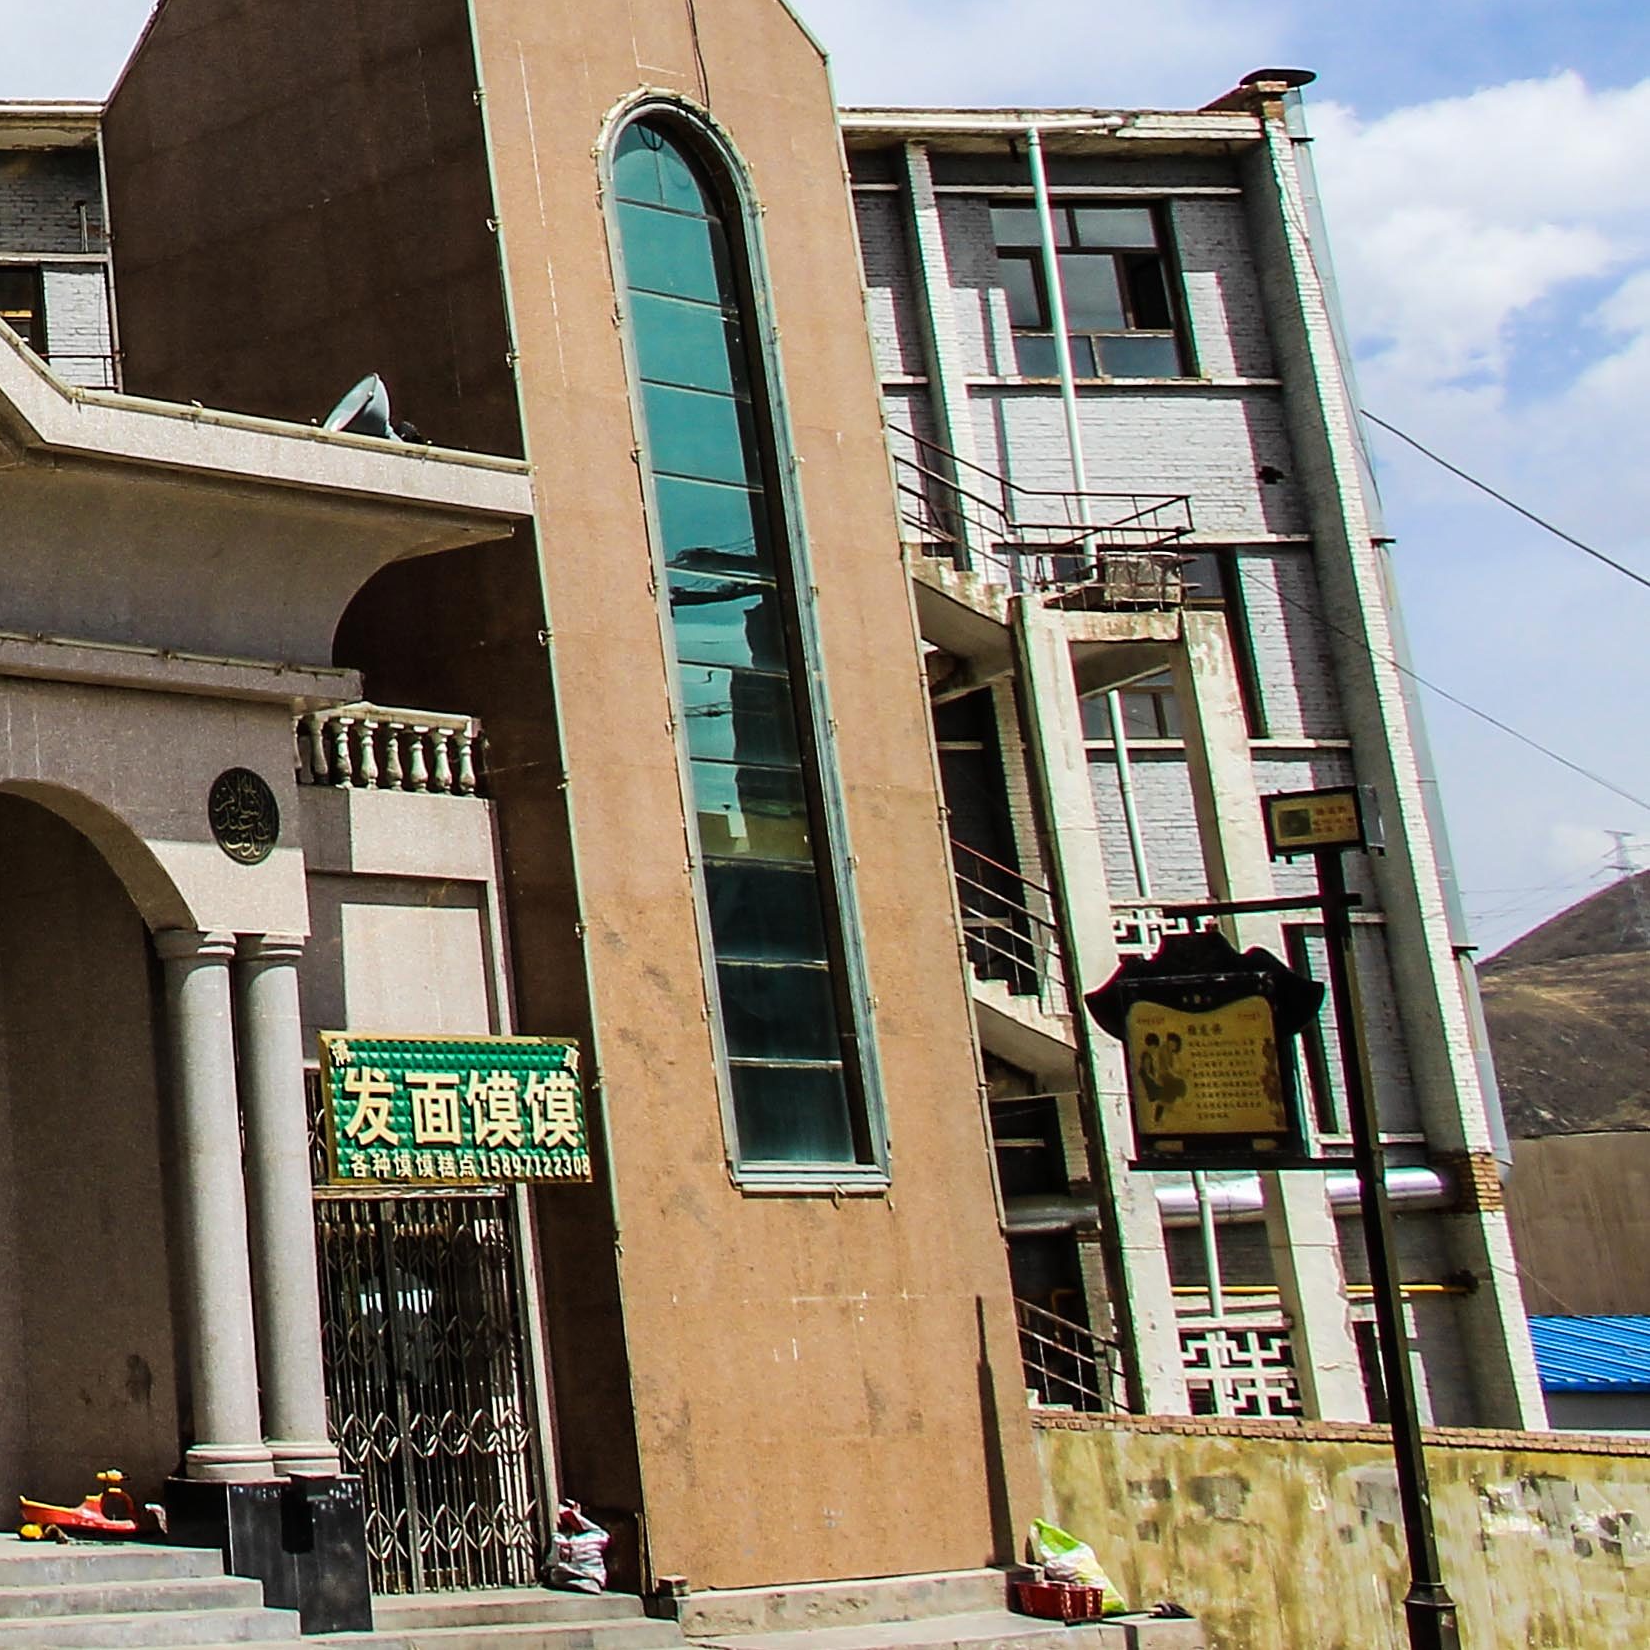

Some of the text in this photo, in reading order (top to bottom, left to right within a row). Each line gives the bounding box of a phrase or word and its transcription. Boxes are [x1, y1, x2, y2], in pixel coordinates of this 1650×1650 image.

[344, 1065, 579, 1148] 发面馍馍
[351, 1154, 591, 1179] 各种馍馍糕点 15897122308
